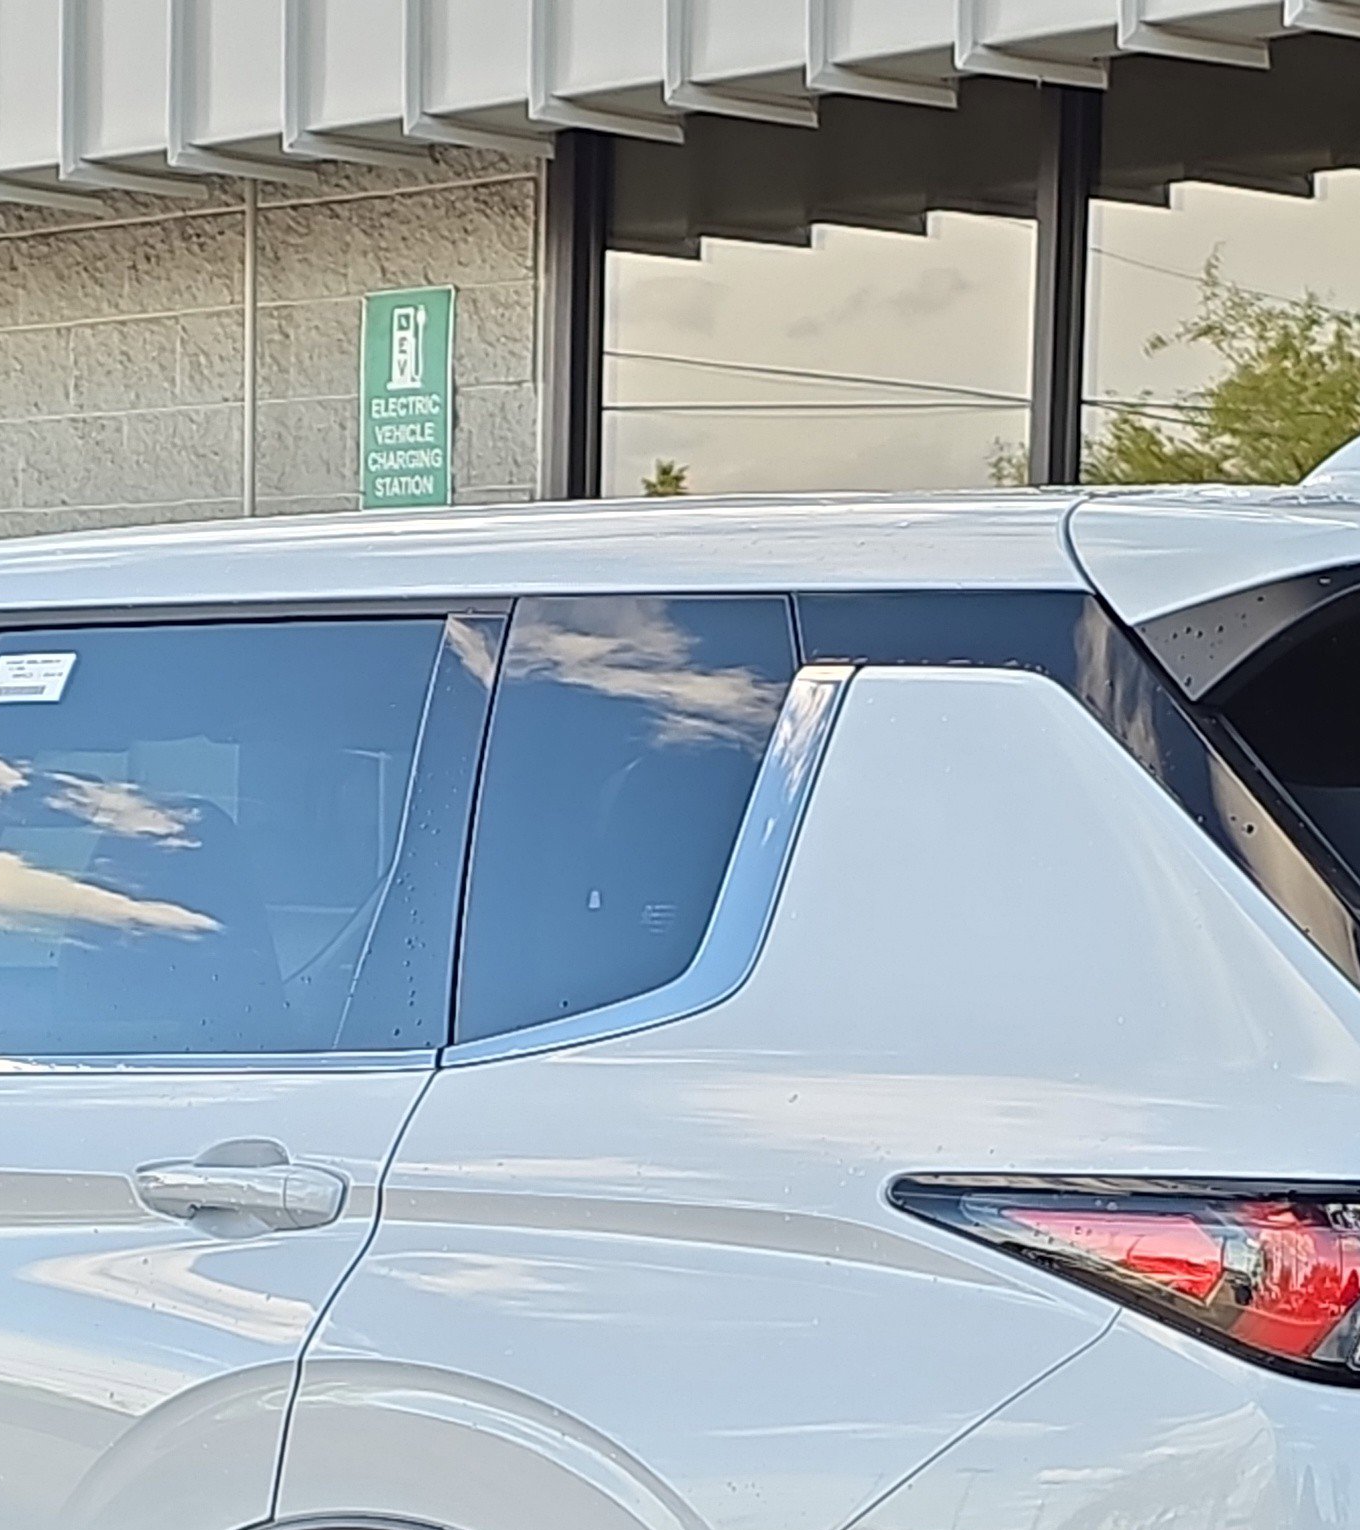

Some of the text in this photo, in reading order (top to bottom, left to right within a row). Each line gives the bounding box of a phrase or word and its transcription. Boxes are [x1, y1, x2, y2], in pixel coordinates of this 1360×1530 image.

[371, 394, 441, 419] ELECTRIC
[375, 422, 436, 445] VEHICLE
[367, 448, 443, 472] CHARGING
[375, 475, 435, 497] STATION
